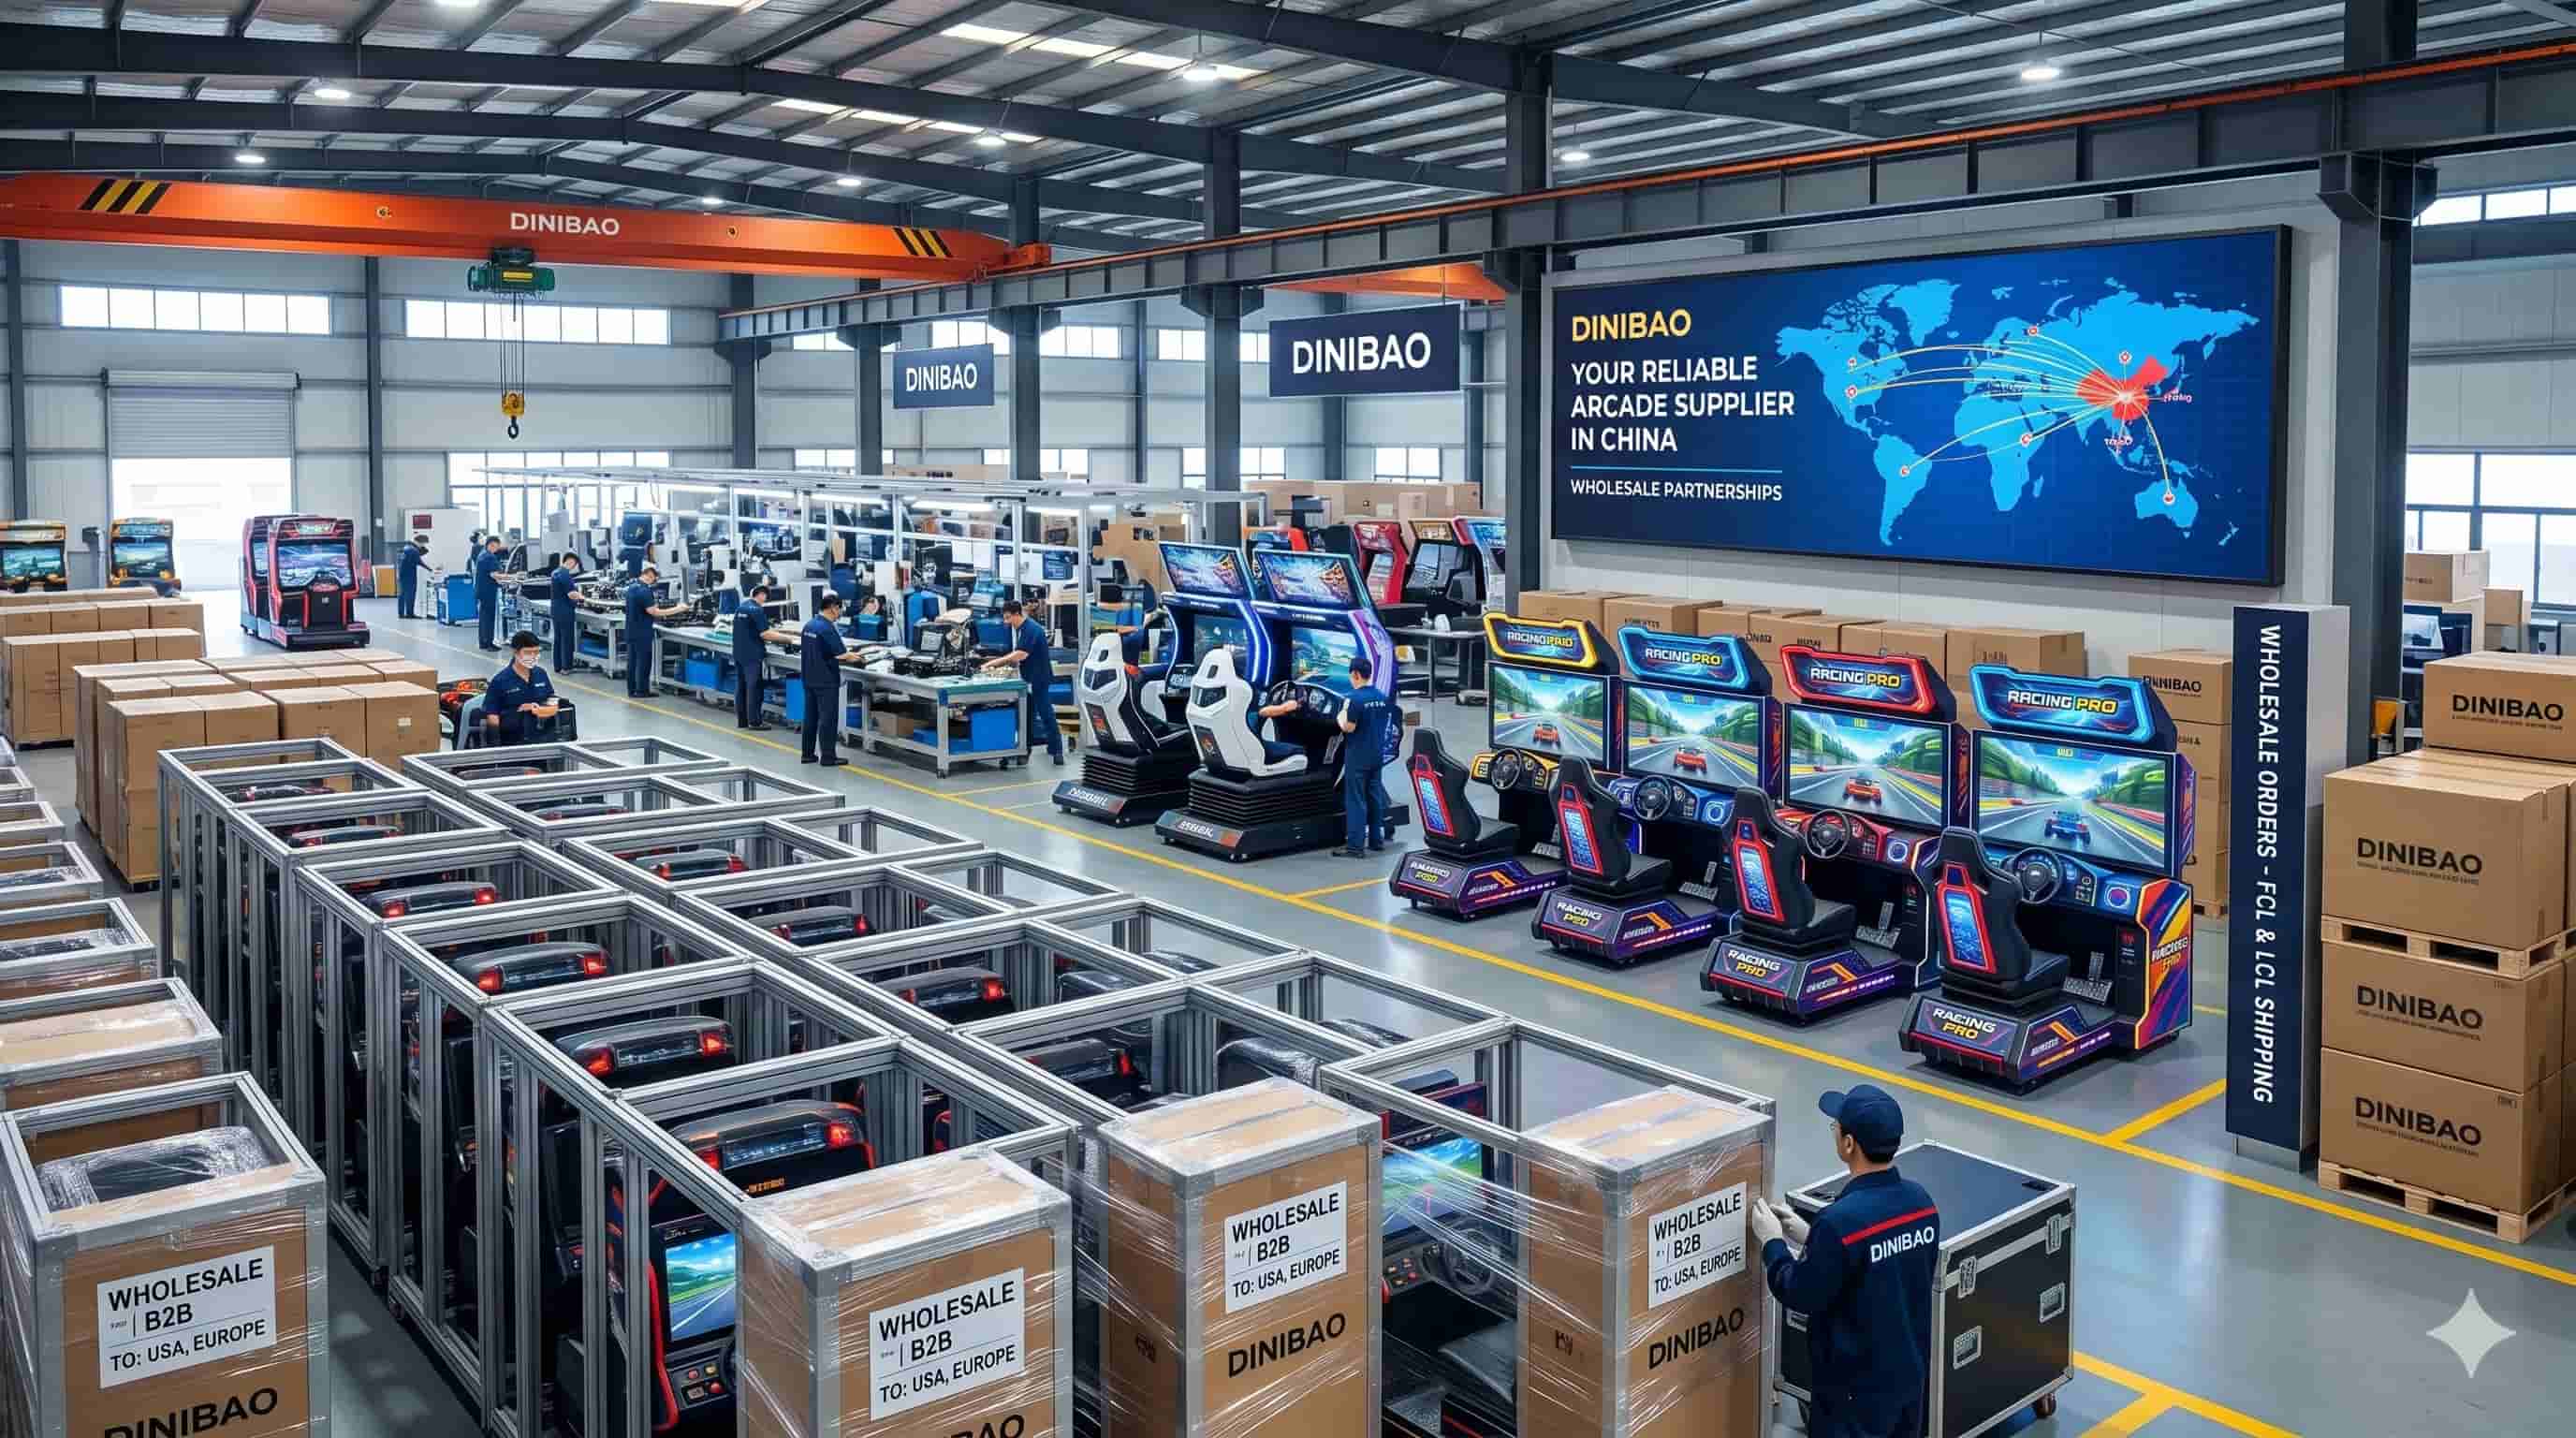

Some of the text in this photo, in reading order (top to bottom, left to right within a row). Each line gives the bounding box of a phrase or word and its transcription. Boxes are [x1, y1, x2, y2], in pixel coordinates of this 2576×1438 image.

[510, 212, 621, 236] DINIBAO
[1572, 309, 1692, 342] DINIBAO
[1293, 331, 1431, 374] DINIBAO
[1571, 356, 1758, 385] YOUR RELIABLE
[905, 362, 978, 391] DINIBAO
[1571, 391, 1794, 418] ARCADE SUPPLIER
[1571, 427, 1678, 451] IN CHINA
[1571, 478, 1782, 501] WHOLESALE PARTNERSHIPS
[1691, 653, 1721, 666] PRO
[1866, 673, 1901, 688] PRO
[2258, 625, 2281, 764] WHOLESALE
[2076, 697, 2118, 713] PRO
[2452, 695, 2564, 721] DINIBAO
[2257, 770, 2278, 858] ORDERS
[2357, 837, 2482, 874] DINIBAO
[2256, 881, 2276, 920] FCL
[2255, 929, 2276, 943] &
[2255, 951, 2276, 989] LCL
[2357, 985, 2482, 1029] DINIBAO
[2253, 996, 2275, 1103] SHIPPING
[2355, 1096, 2481, 1146] DINIBAO
[1232, 1193, 1339, 1242] WHOLESALE
[1654, 1192, 1741, 1241] WHOLESALE
[1257, 1235, 1290, 1262] B2B
[1674, 1233, 1701, 1259] B2B
[1870, 1226, 1935, 1263] DINIBAO
[109, 1257, 263, 1311] WHOLESALE
[1233, 1249, 1339, 1298] TO: USA, EUROPE
[1655, 1246, 1741, 1294] TO: USA, EUROPE
[145, 1302, 193, 1331] B2B
[879, 1281, 1015, 1341] WHOLESALE
[110, 1319, 266, 1371] TO: USA, EUROPE
[911, 1329, 953, 1360] B2B
[1228, 1313, 1346, 1378] DINIBAO
[1648, 1308, 1744, 1370] DINIBAO
[880, 1344, 1016, 1402] TO: USA, EUROPE
